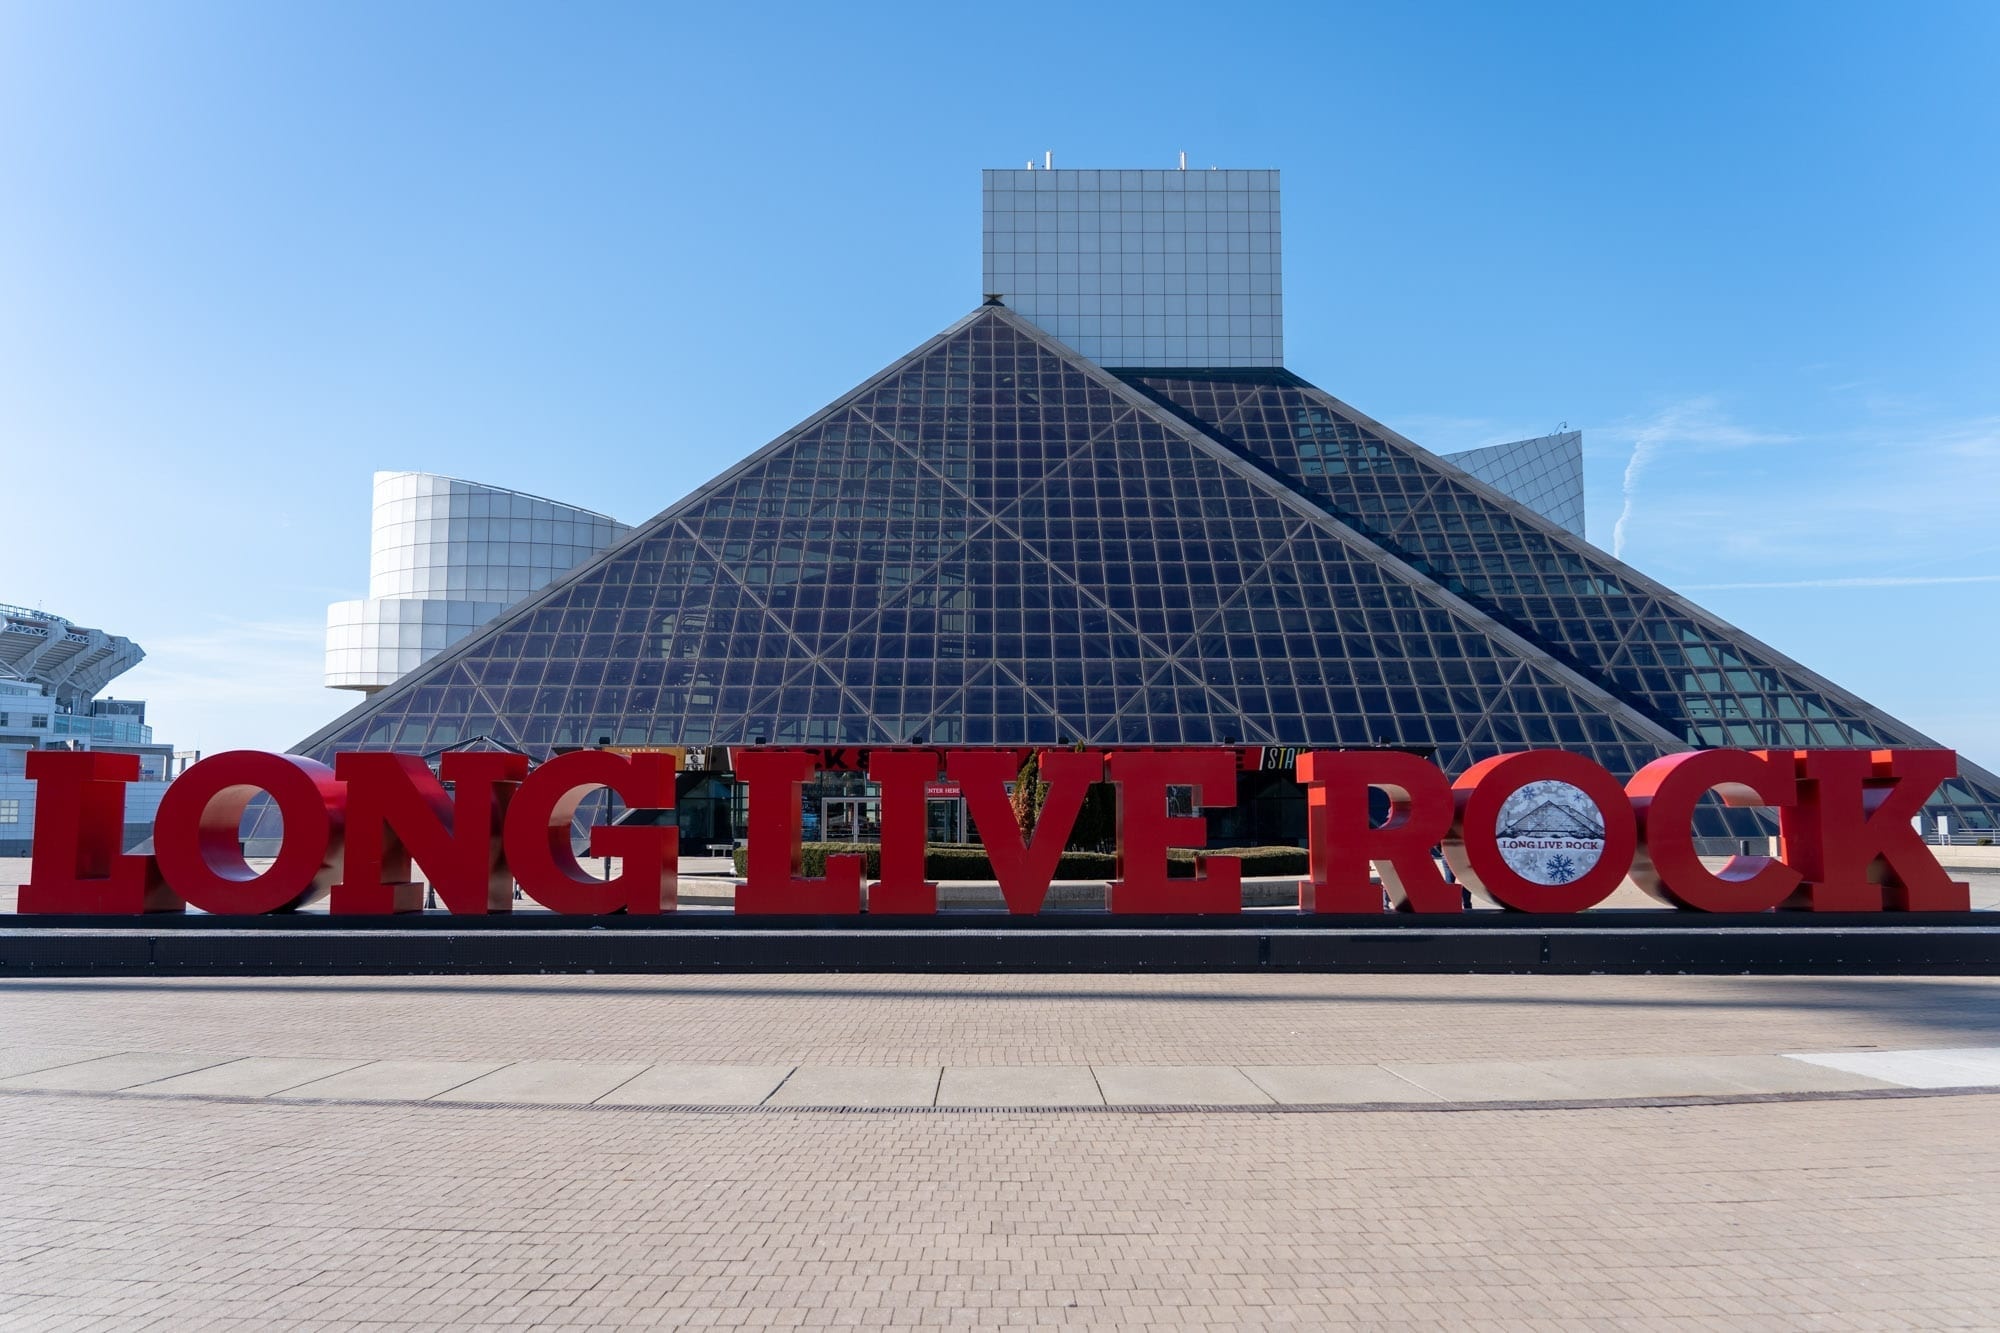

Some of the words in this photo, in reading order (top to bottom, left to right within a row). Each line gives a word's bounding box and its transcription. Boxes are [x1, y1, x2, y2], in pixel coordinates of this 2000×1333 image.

[17, 749, 677, 915] LONG
[735, 750, 1242, 915] LIVE
[1295, 748, 1971, 914] ROCK
[1502, 840, 1535, 849] LONG
[1538, 841, 1563, 849] LIVE
[1565, 841, 1599, 850] ROCK
